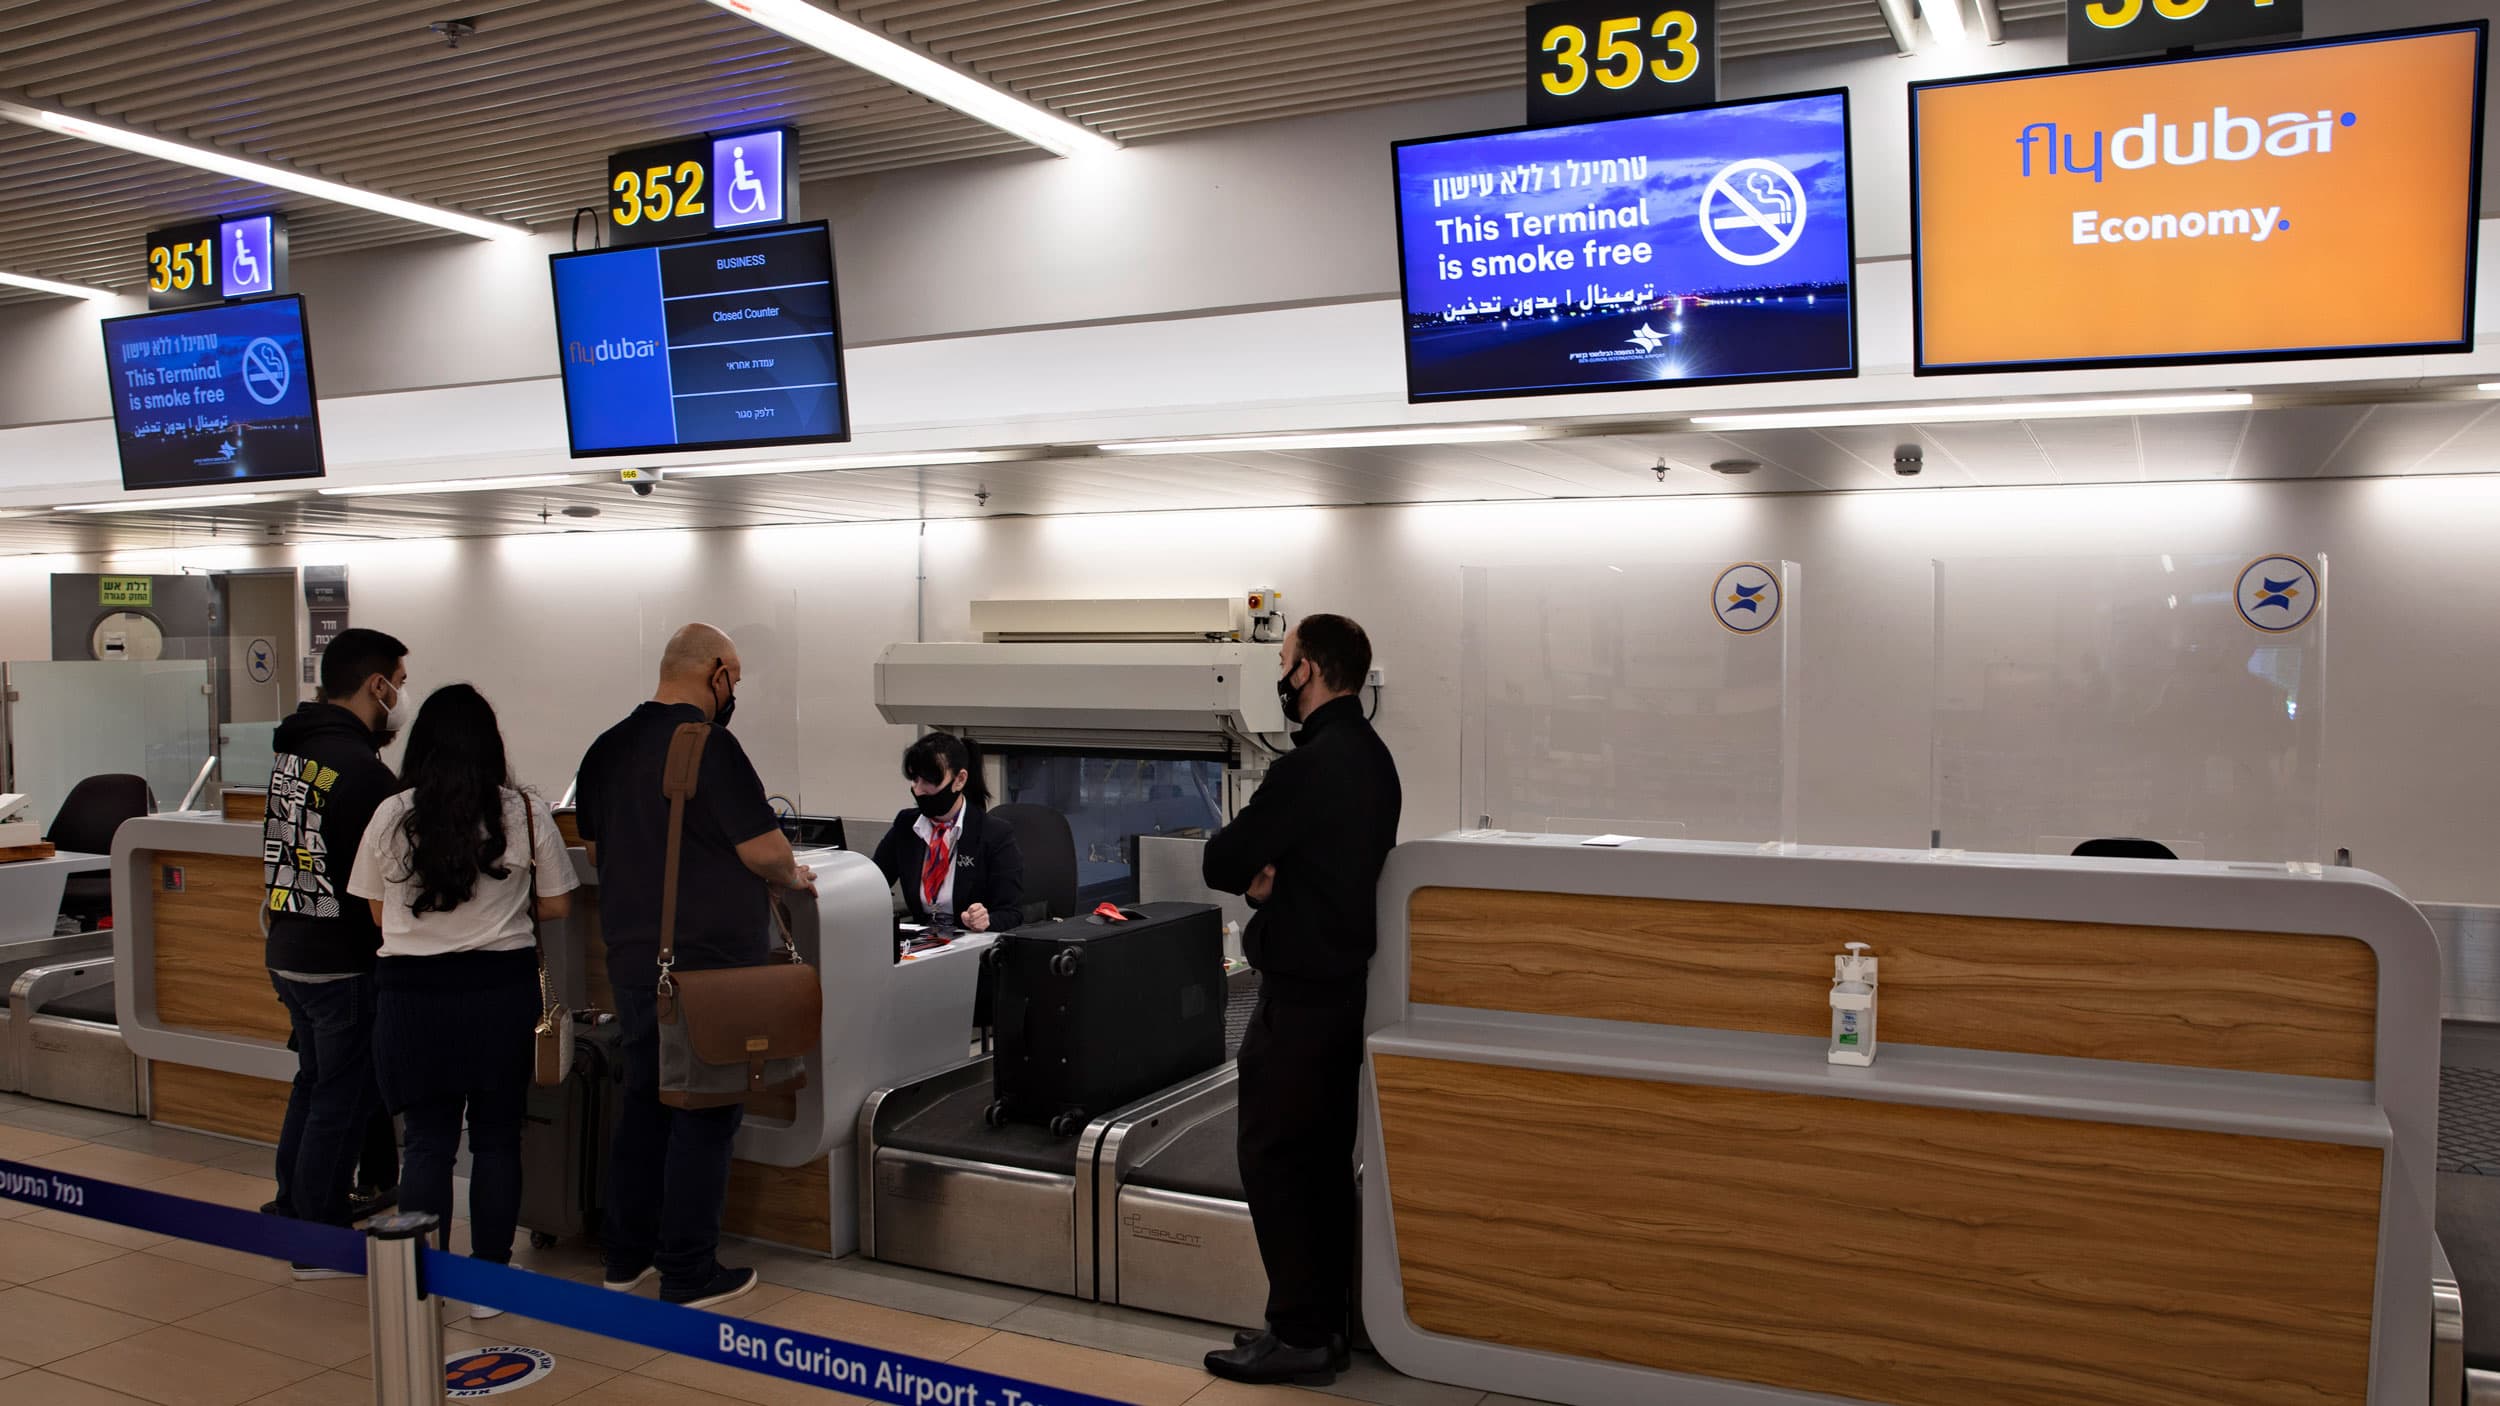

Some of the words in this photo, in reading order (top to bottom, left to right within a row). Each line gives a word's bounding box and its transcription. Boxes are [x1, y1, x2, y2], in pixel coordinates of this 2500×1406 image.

[1541, 9, 1699, 95] 353
[2016, 107, 2333, 183] flydubai
[1501, 165, 1543, 195] ללא
[1551, 165, 1560, 189] 1
[1568, 155, 1647, 188] טרמינל
[612, 160, 704, 226] 352
[1433, 172, 1494, 207] עישון
[1436, 216, 1499, 245] This
[1506, 198, 1649, 238] Terminal
[150, 239, 213, 293] 351
[717, 254, 766, 270] BUSINESS
[1438, 254, 1463, 280] is
[1472, 243, 1574, 275] smoke
[1583, 240, 1653, 268] free
[1510, 294, 1557, 317] بدون
[1581, 282, 1655, 312] ترمينال
[713, 310, 742, 322] Closed
[745, 307, 779, 319] Counter
[1442, 297, 1501, 322] تدخين
[122, 341, 150, 363] עישון
[152, 336, 172, 356] ללא
[181, 334, 218, 352] טרמינל
[569, 338, 655, 366] flydubai
[126, 368, 155, 387] This
[156, 360, 222, 384] Terminal
[726, 360, 750, 370] אחראי
[752, 358, 774, 369] עמדת
[129, 394, 141, 410] is
[144, 388, 190, 409] smoke
[193, 386, 224, 404] free
[736, 410, 752, 419] סגור
[754, 407, 774, 420] דלפק
[134, 421, 161, 438] تدخين
[164, 422, 186, 435] بدون
[104, 582, 121, 590] אש
[127, 581, 147, 591] דלת
[52, 1176, 83, 1206] נמל
[719, 1322, 767, 1362] Ben
[775, 1337, 866, 1385] Gurion
[875, 1361, 977, 1406] Airport
